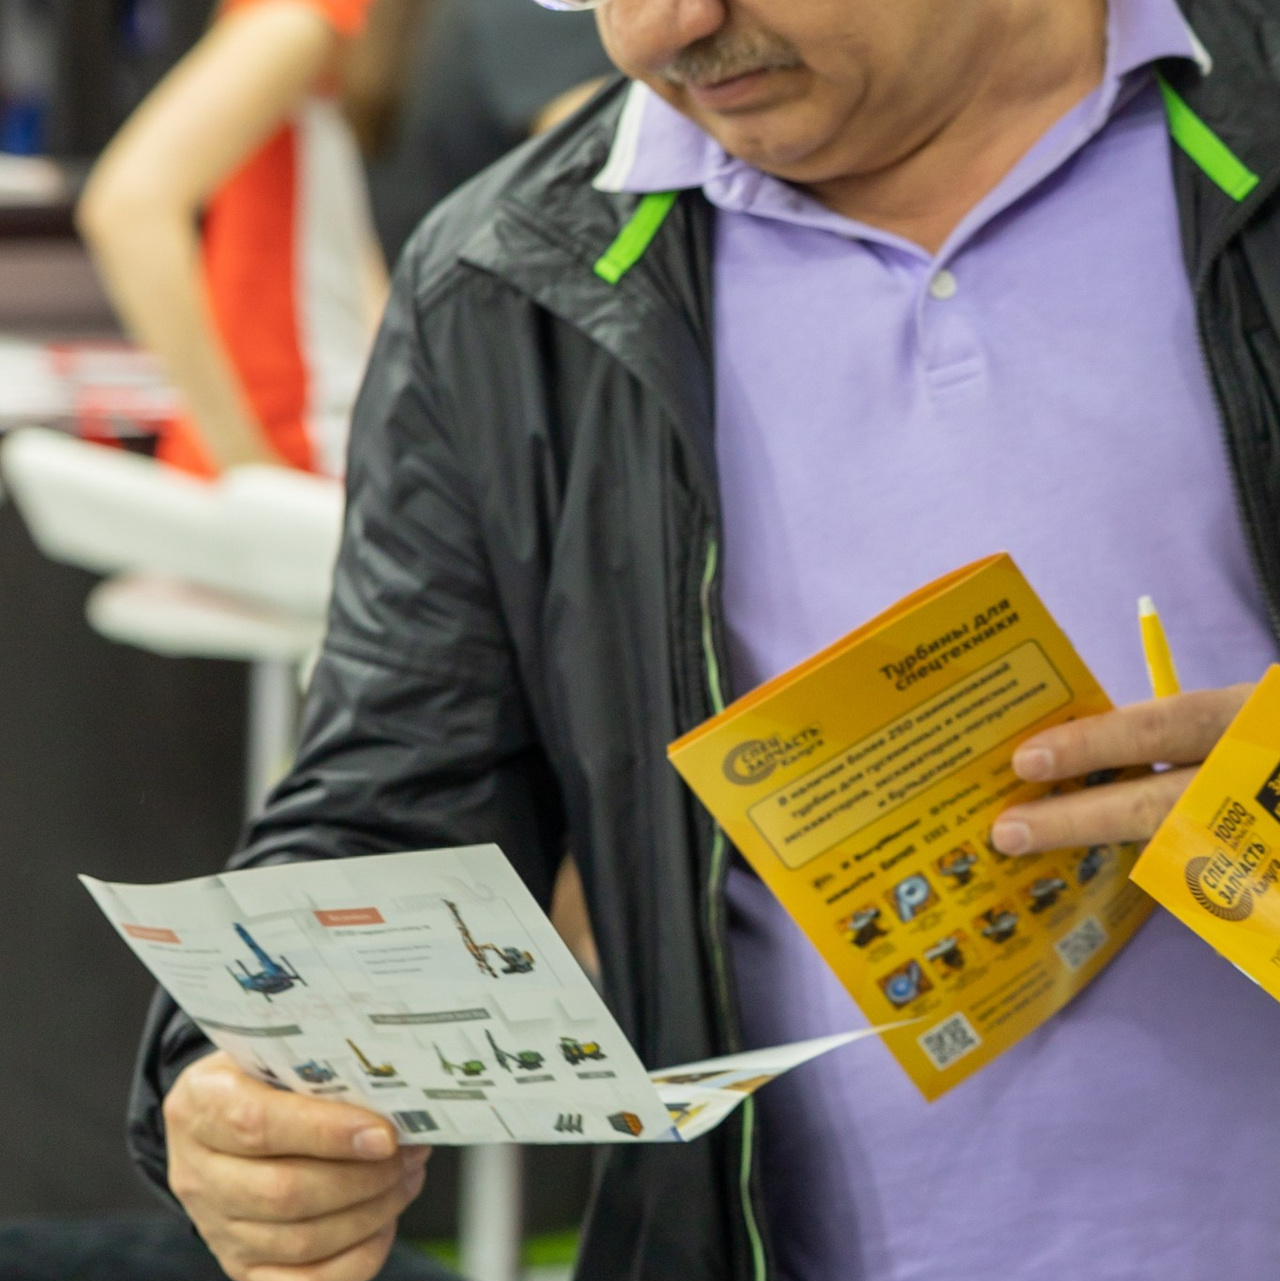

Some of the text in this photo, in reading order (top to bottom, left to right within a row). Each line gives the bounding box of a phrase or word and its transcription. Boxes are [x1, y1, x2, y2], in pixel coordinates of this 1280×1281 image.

[879, 598, 1010, 680] Турбины для
[896, 612, 1019, 691] спецтехники
[741, 735, 779, 763] СПЕЦ
[745, 727, 819, 771] ЗАПЧАСТЬ
[846, 738, 886, 765] более
[840, 772, 864, 792] для
[1214, 801, 1248, 843] 10000
[1203, 853, 1233, 890] СПЕЦ
[1218, 843, 1266, 905] ЗАПЧАСТЬ
